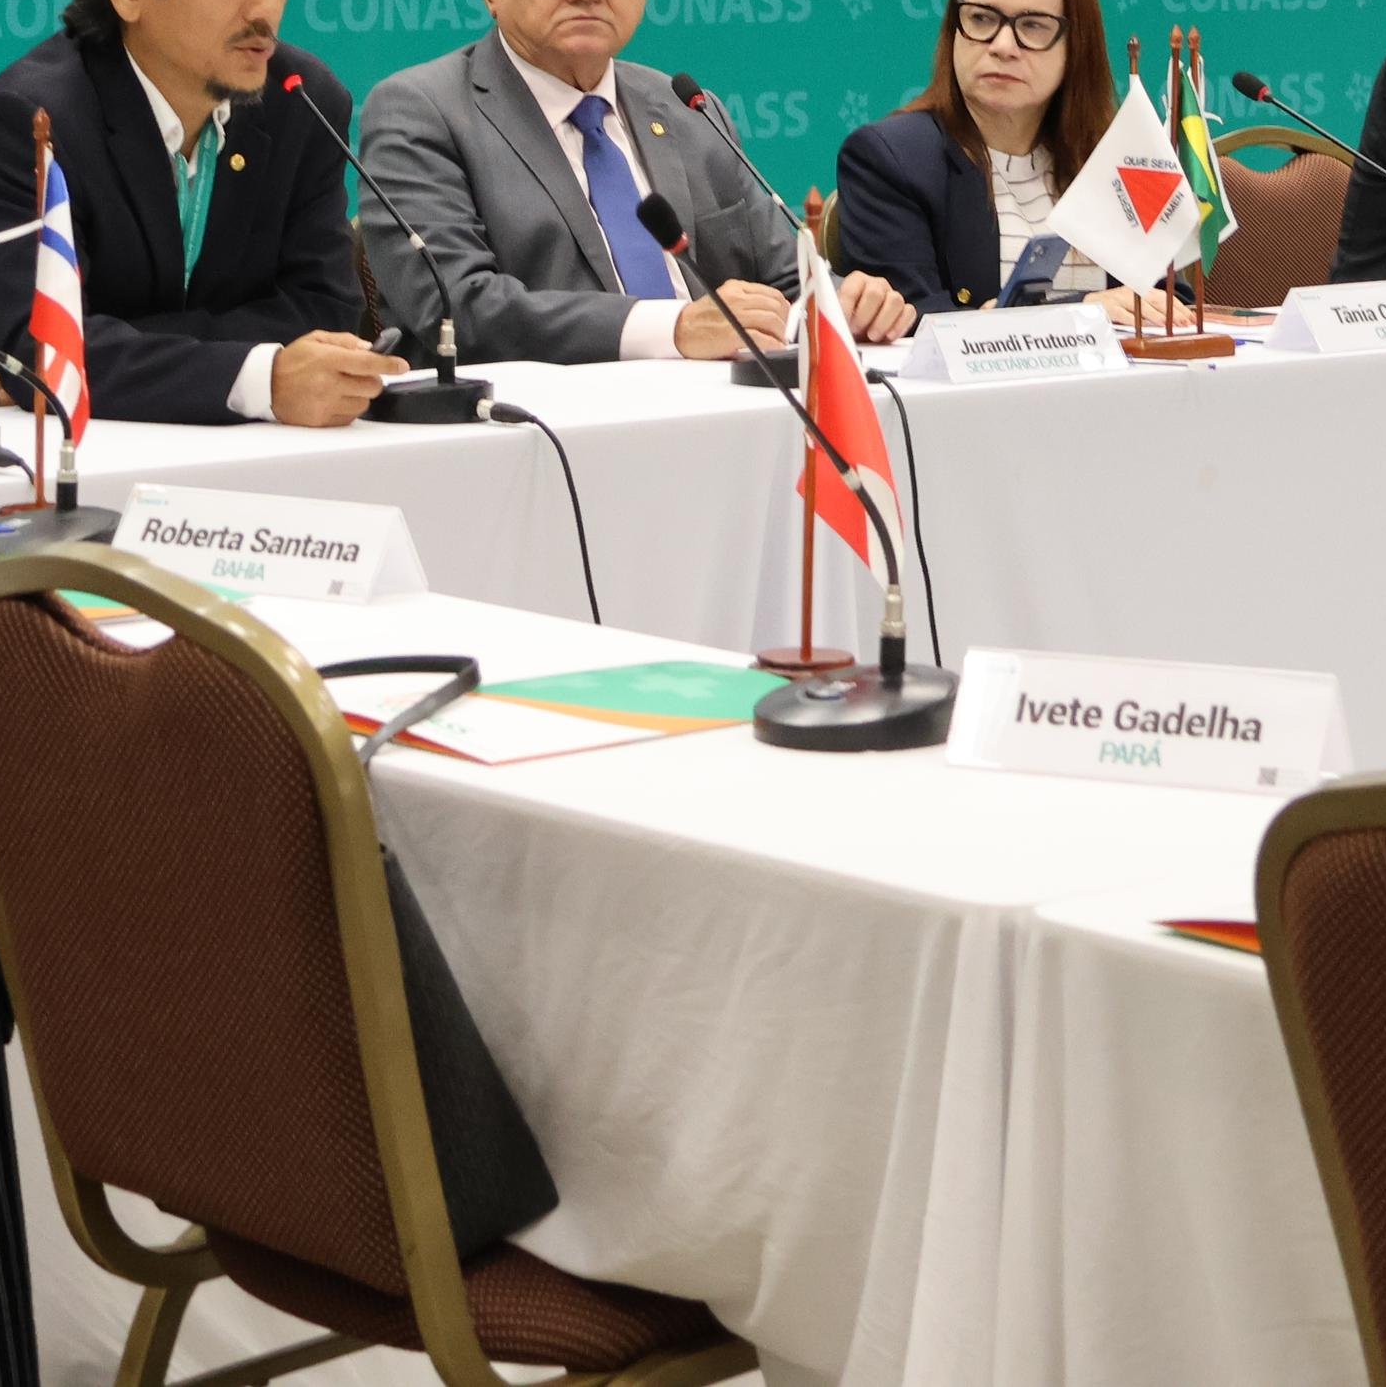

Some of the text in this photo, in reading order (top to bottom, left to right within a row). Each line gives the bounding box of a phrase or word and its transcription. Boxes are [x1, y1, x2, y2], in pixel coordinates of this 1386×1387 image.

[1331, 303, 1378, 324] Tânia
[961, 332, 1096, 355] Jurandi Frutuoso
[141, 517, 361, 564] Roberta Santana
[212, 558, 266, 581] BAHIA
[1015, 692, 1263, 743] Ivete Gadelha
[1099, 740, 1161, 768] PARÁ
